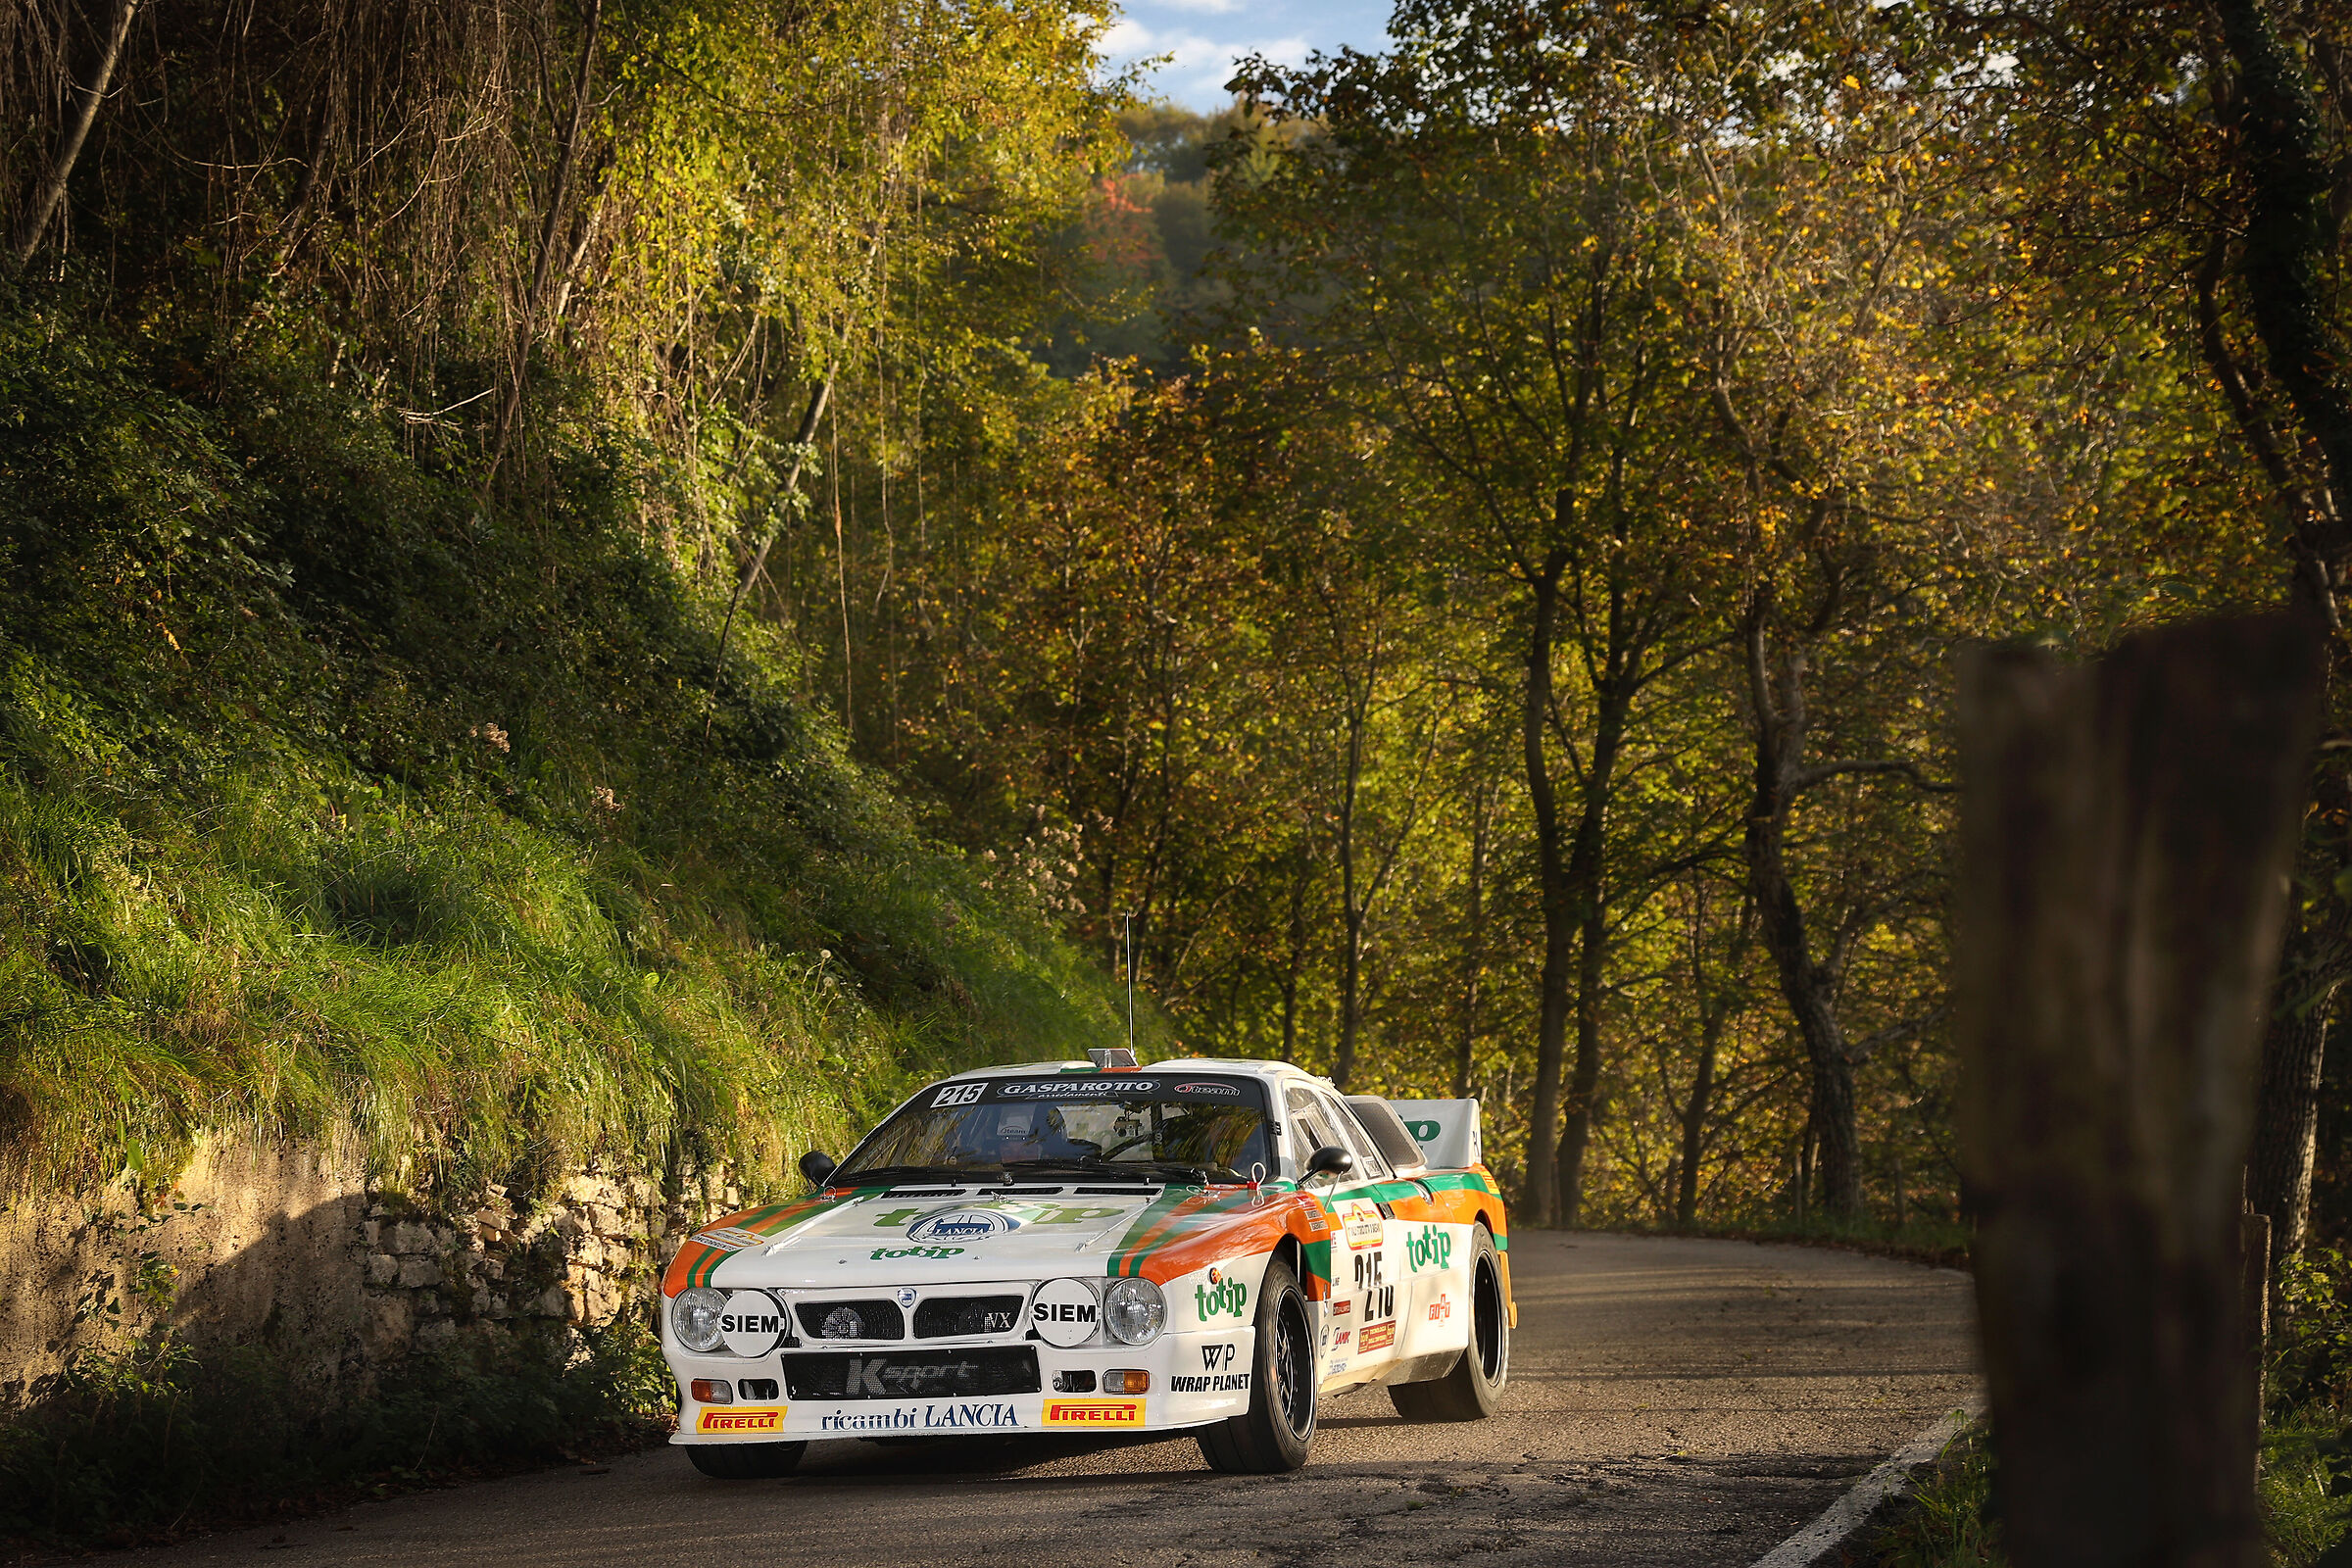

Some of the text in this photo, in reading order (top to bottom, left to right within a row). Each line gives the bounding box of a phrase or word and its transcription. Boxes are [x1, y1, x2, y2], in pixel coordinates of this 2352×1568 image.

[939, 1084, 980, 1104] 215
[1004, 1080, 1154, 1094] GASPAROTTO
[935, 1225, 988, 1236] LANCIA
[869, 1246, 965, 1260] totip
[1406, 1224, 1450, 1273] totip
[1195, 1277, 1248, 1321] totip
[1033, 1303, 1097, 1323] SIEM
[721, 1314, 779, 1334] SIEM
[1170, 1373, 1250, 1393] WRAP PLANET
[702, 1412, 779, 1429] PIRELLI
[820, 1403, 1020, 1431] ricambi LANCIA
[1050, 1403, 1138, 1421] PIRELLI
